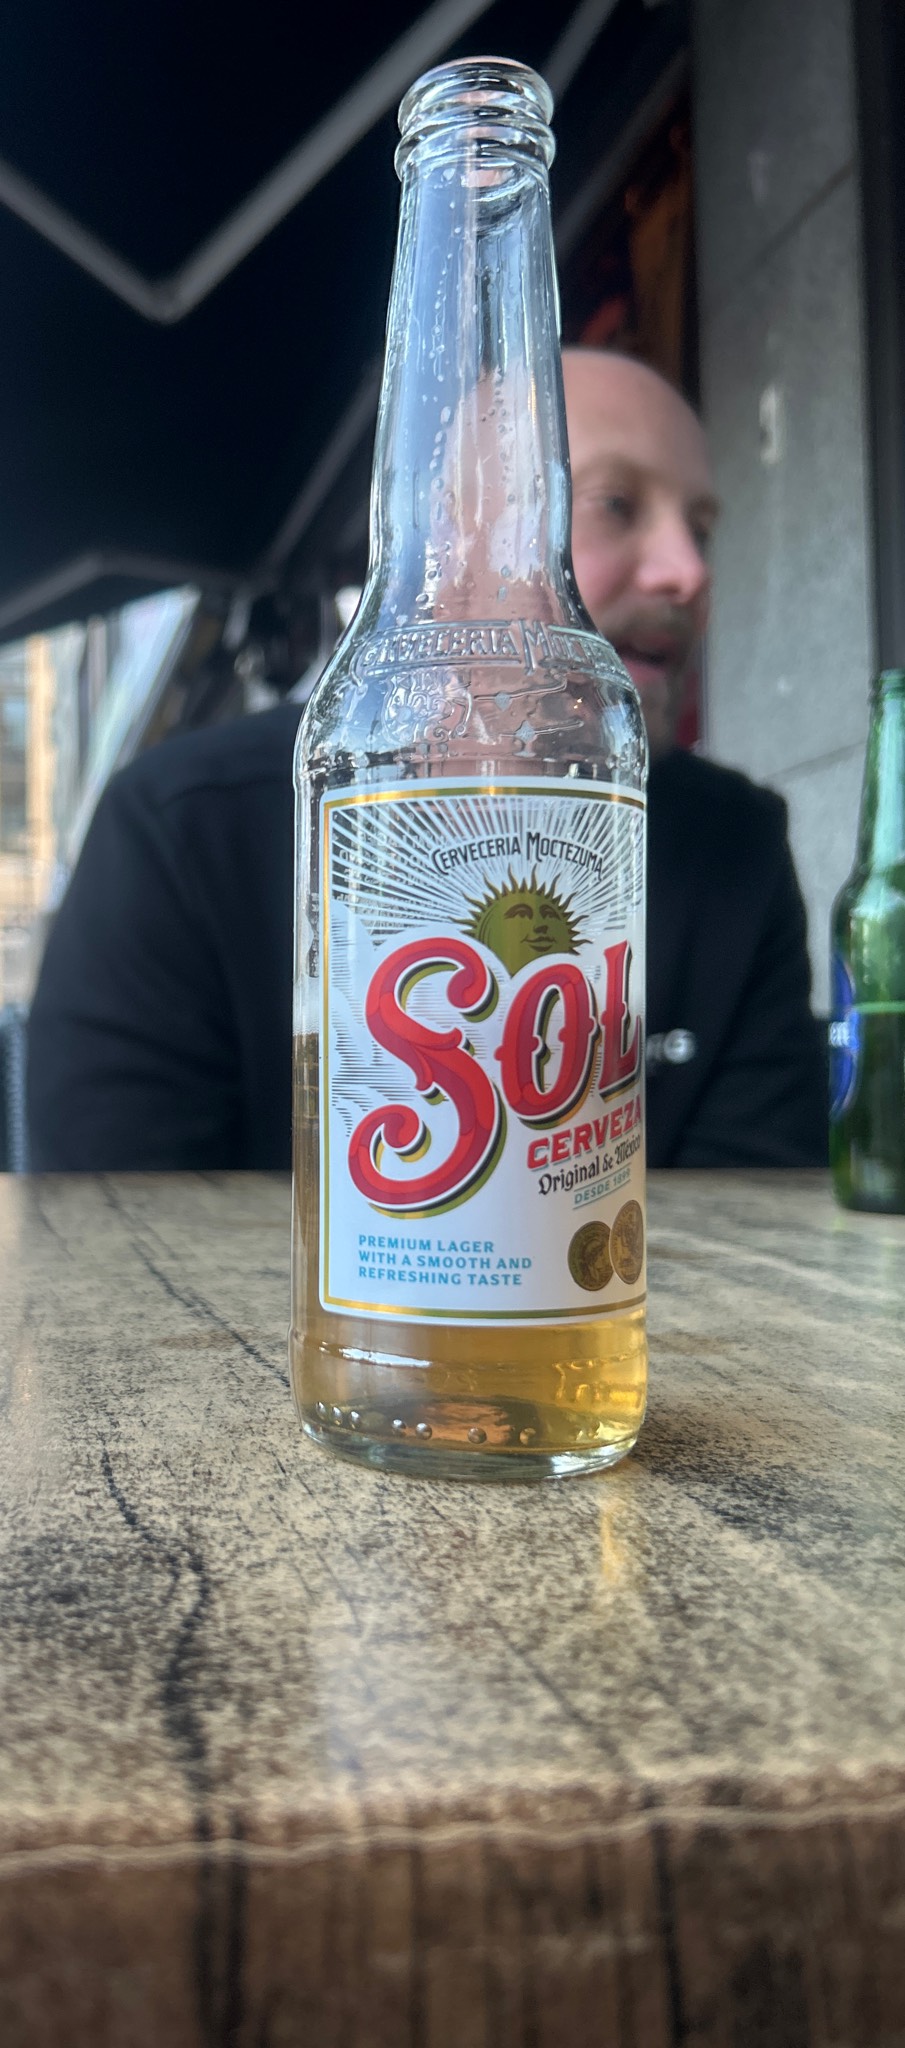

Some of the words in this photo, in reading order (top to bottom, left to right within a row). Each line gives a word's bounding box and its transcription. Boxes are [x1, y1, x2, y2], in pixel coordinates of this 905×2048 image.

[432, 836, 521, 876] CERVECERIA
[526, 832, 603, 882] MOCTEZUMA
[348, 936, 644, 1220] SOL
[526, 1093, 642, 1172] CERVEZA
[538, 1155, 600, 1196] Original
[602, 1153, 614, 1173] de
[574, 1179, 610, 1205] DESDE
[358, 1234, 431, 1251] PREMIUM
[437, 1239, 494, 1253] LAGER
[358, 1250, 396, 1265] WITH
[401, 1254, 412, 1267] A
[417, 1255, 491, 1269] SMOOTH
[496, 1257, 532, 1269] AND
[358, 1266, 462, 1285] REFRESHING
[467, 1273, 523, 1286] TASTE
